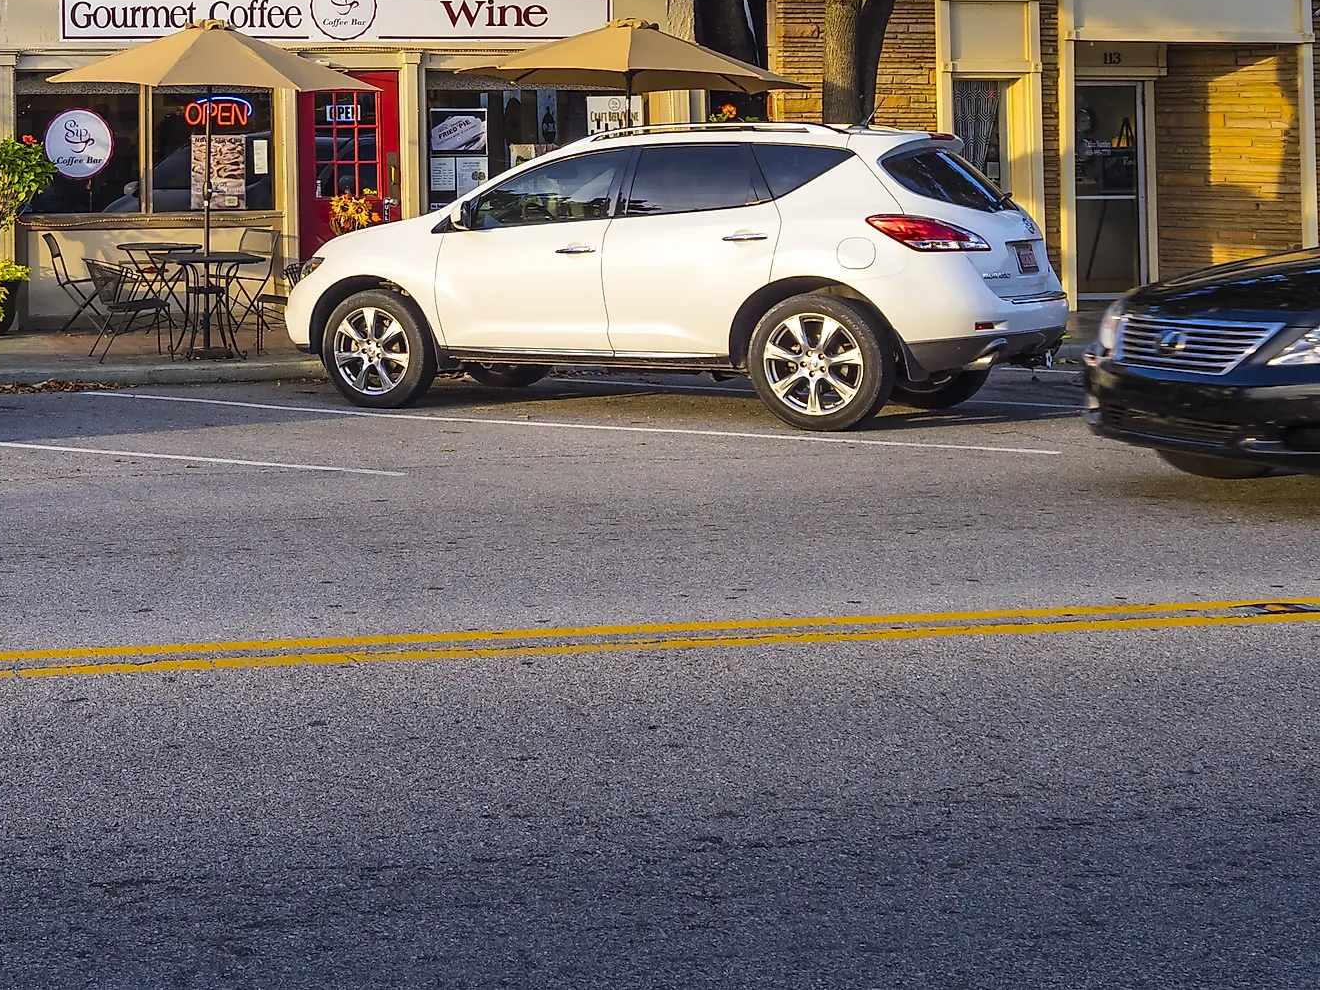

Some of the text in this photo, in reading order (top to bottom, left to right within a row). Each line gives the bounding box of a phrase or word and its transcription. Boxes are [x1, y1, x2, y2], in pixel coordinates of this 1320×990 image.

[70, 1, 197, 29] Gourmet
[322, 18, 367, 28] Coffee Bar
[1103, 52, 1122, 65] 113
[184, 102, 249, 126] OPEN
[329, 106, 359, 120] OPEN
[64, 119, 89, 142] Sip
[438, 126, 458, 140] FRIED
[458, 119, 472, 129] PIE
[56, 156, 103, 166] Coffee Bar
